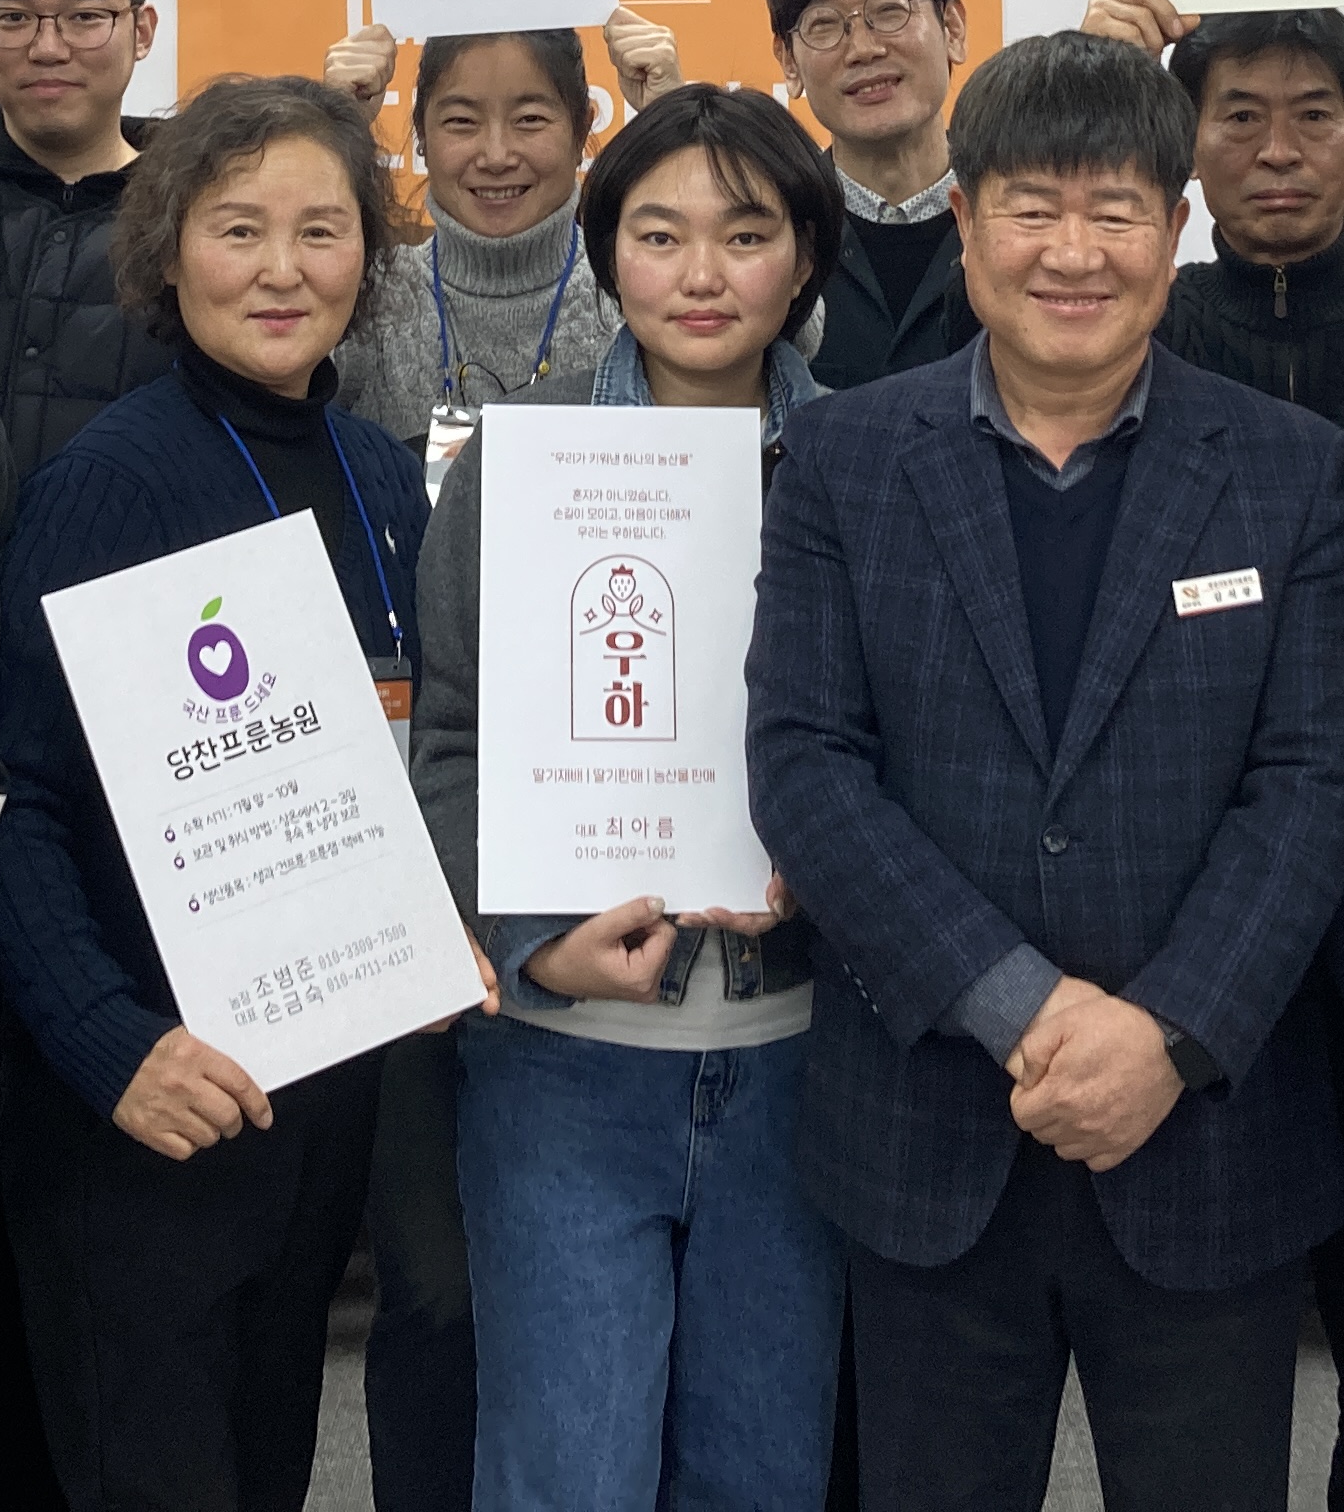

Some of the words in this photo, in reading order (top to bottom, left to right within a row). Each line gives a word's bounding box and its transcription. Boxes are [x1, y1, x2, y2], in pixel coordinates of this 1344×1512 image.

[603, 630, 649, 729] 우하
[166, 700, 322, 781] 당찬프룬농원
[592, 767, 644, 784] 딸기판매
[574, 823, 598, 838] 대표
[606, 816, 675, 840] 최아름
